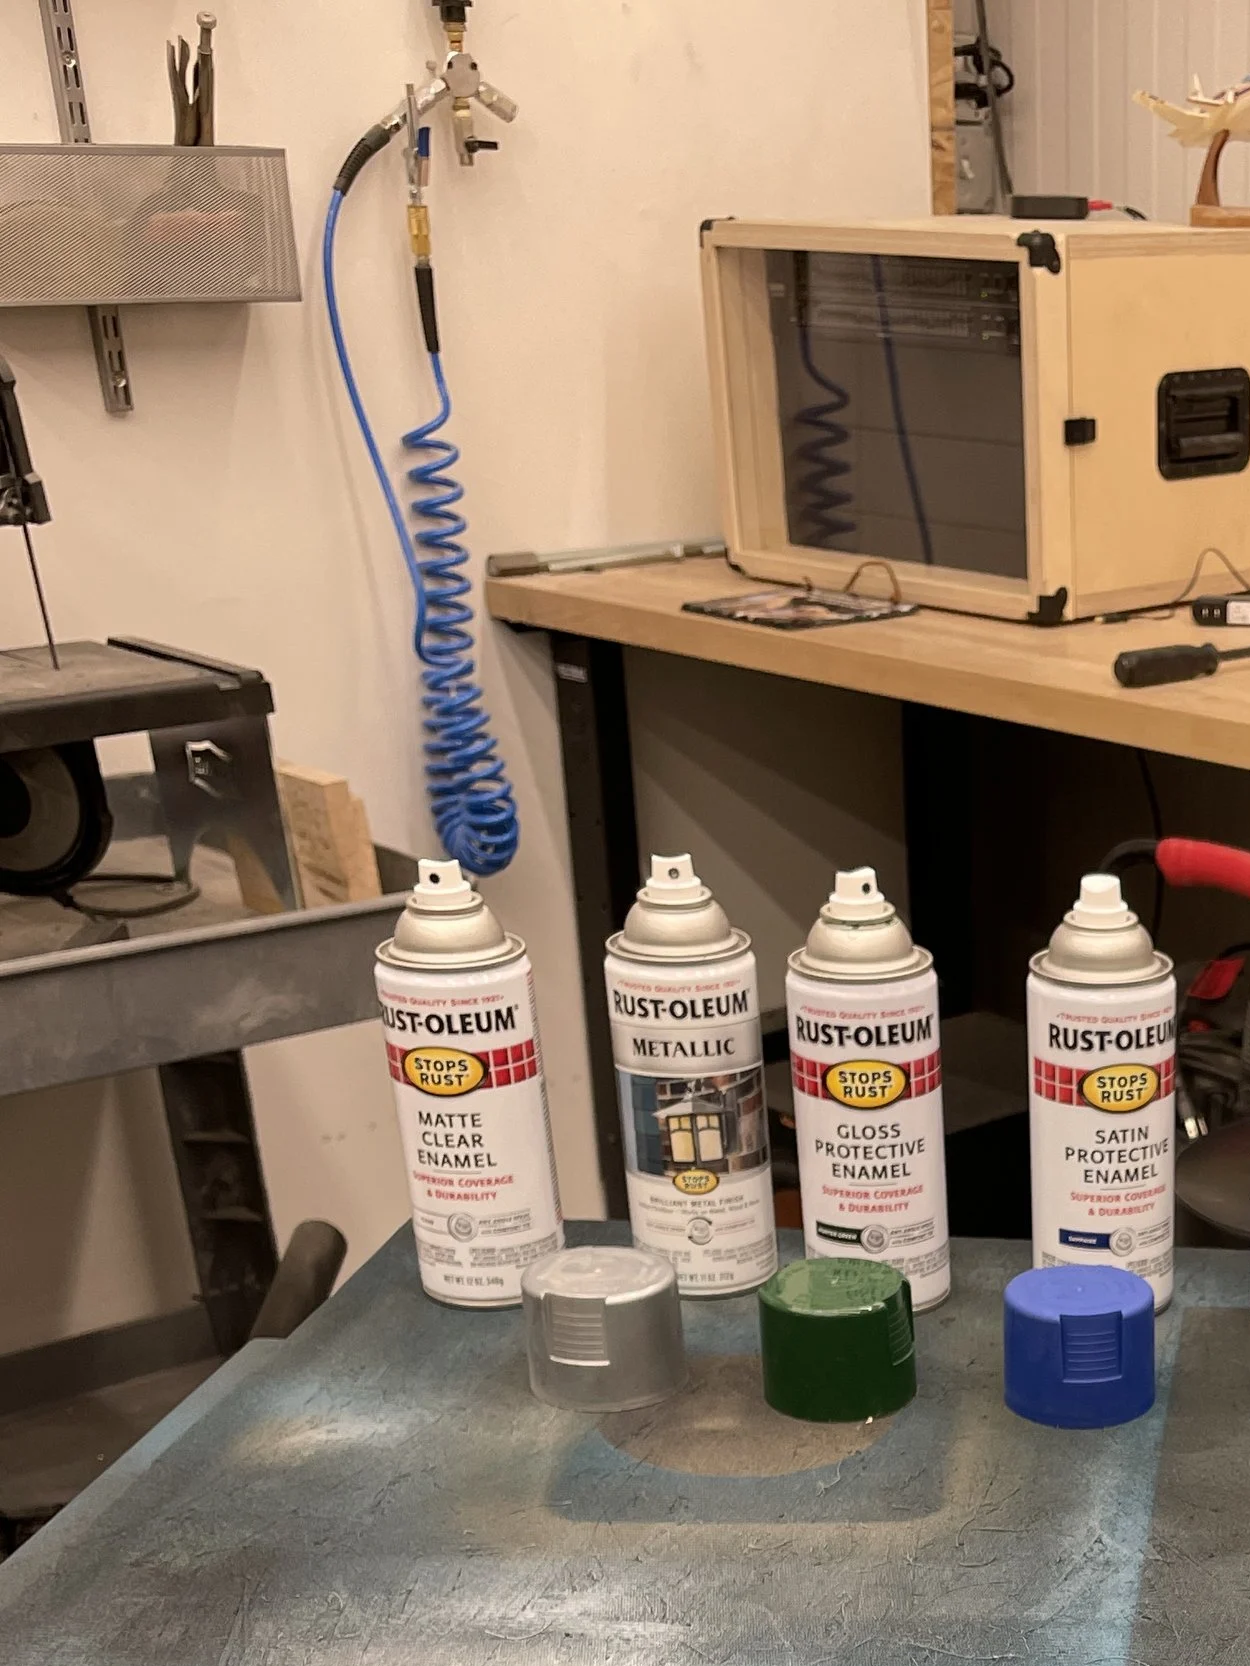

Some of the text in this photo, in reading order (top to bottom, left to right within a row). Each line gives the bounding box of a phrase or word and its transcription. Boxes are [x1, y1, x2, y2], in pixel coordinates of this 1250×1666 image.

[613, 990, 748, 1020] RUST-OLEUM
[796, 1015, 932, 1047] RUST-OLEUM
[633, 1037, 736, 1057] METALLIC
[414, 1057, 468, 1072] STOPS
[420, 1073, 465, 1086] RUST
[838, 1071, 892, 1084] STOPS
[1096, 1073, 1147, 1088] STOPS
[843, 1085, 888, 1098] RUST
[1101, 1088, 1144, 1103] RUST
[419, 1111, 482, 1128] MATTE
[422, 1131, 484, 1148] CLEAR
[837, 1124, 901, 1140] GLOSS
[1095, 1126, 1149, 1144] SATIN
[815, 1138, 925, 1161] PROTECTIVE
[1065, 1138, 1169, 1164] PROTECTIVE
[418, 1149, 497, 1168] ENAMEL
[413, 1171, 514, 1188] SUPERIOR COVERAGE
[682, 1175, 709, 1183] STOPS
[832, 1163, 911, 1180] ENAMEL
[1084, 1164, 1158, 1184] ENAMEL
[427, 1189, 497, 1201] & DURABILITY
[822, 1184, 923, 1200] SUPERIOR COVERAGE
[1071, 1184, 1166, 1203] SUPERIOR COVERAGE
[839, 1201, 909, 1213] & DURABILITY
[1088, 1203, 1155, 1216] & DURABILITY
